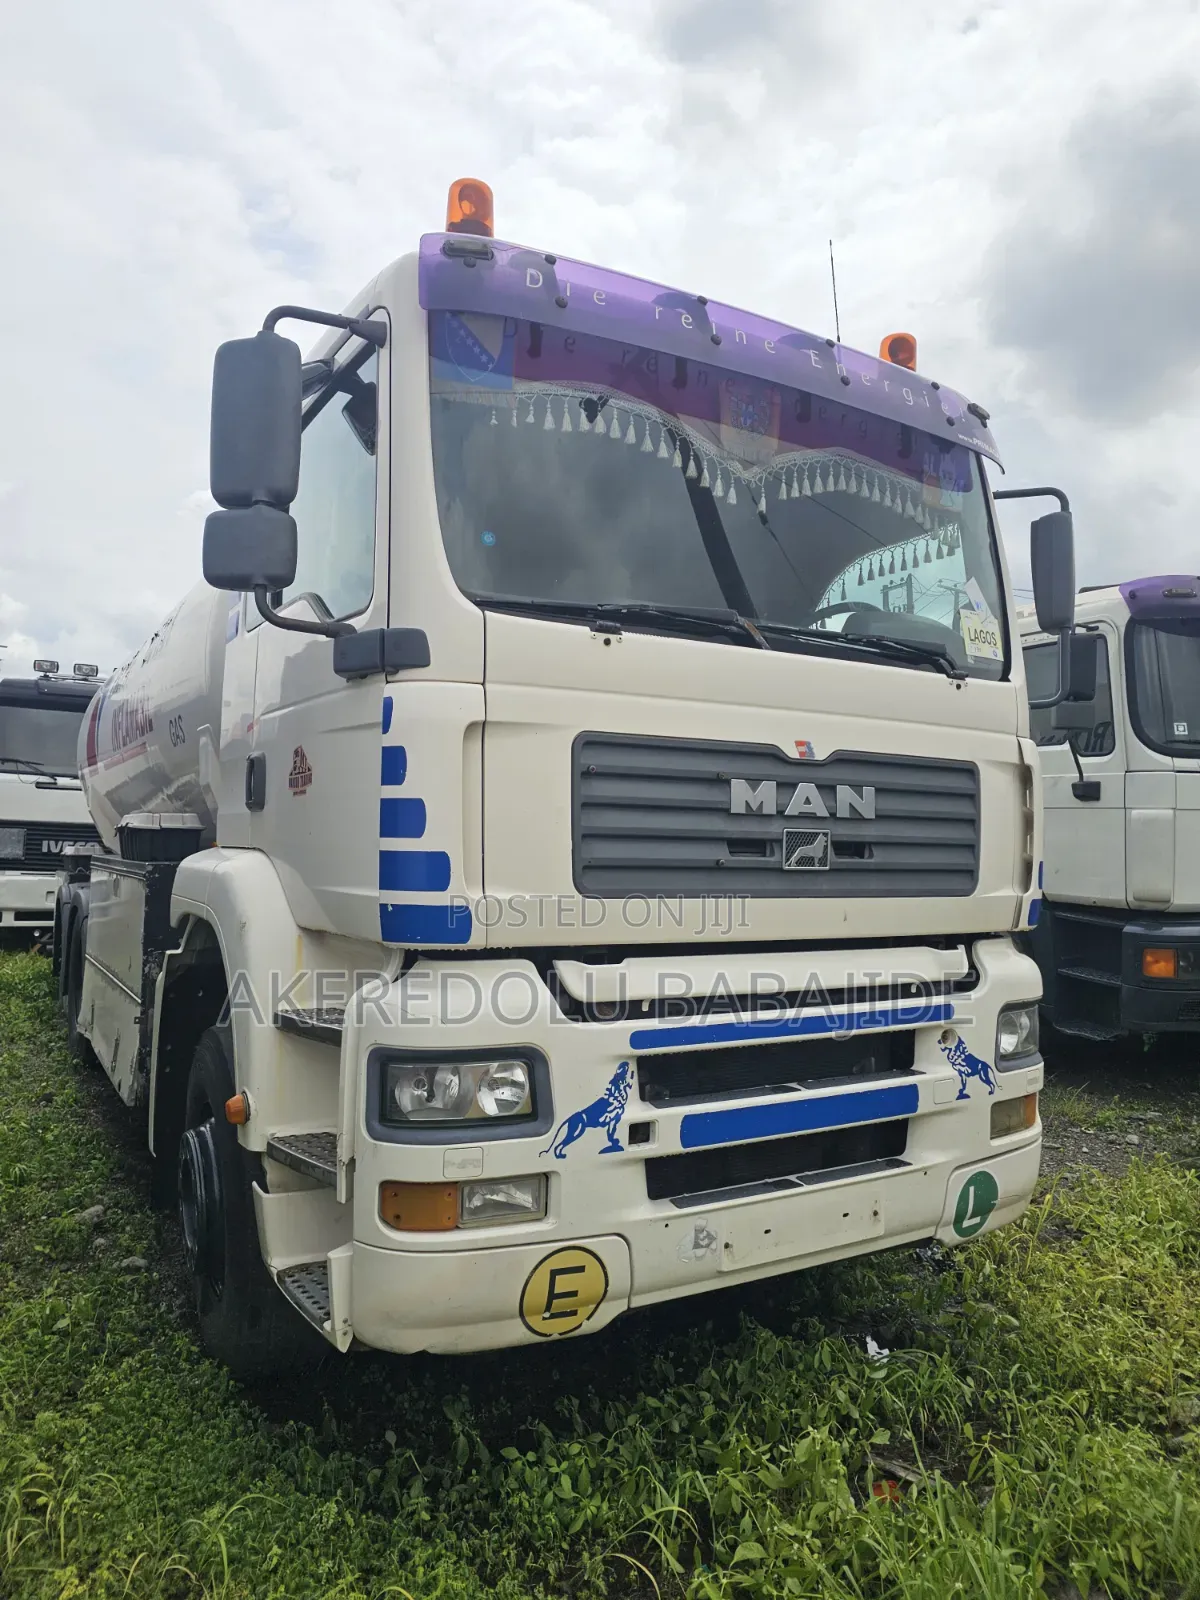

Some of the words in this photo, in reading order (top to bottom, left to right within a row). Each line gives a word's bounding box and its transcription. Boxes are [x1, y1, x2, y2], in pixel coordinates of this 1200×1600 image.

[525, 267, 606, 305] Die
[655, 305, 776, 354] reine
[967, 627, 998, 647] LAGOS
[168, 714, 186, 748] GAS
[730, 778, 876, 820] MAN
[962, 1185, 981, 1229] L
[541, 1264, 586, 1322] E
